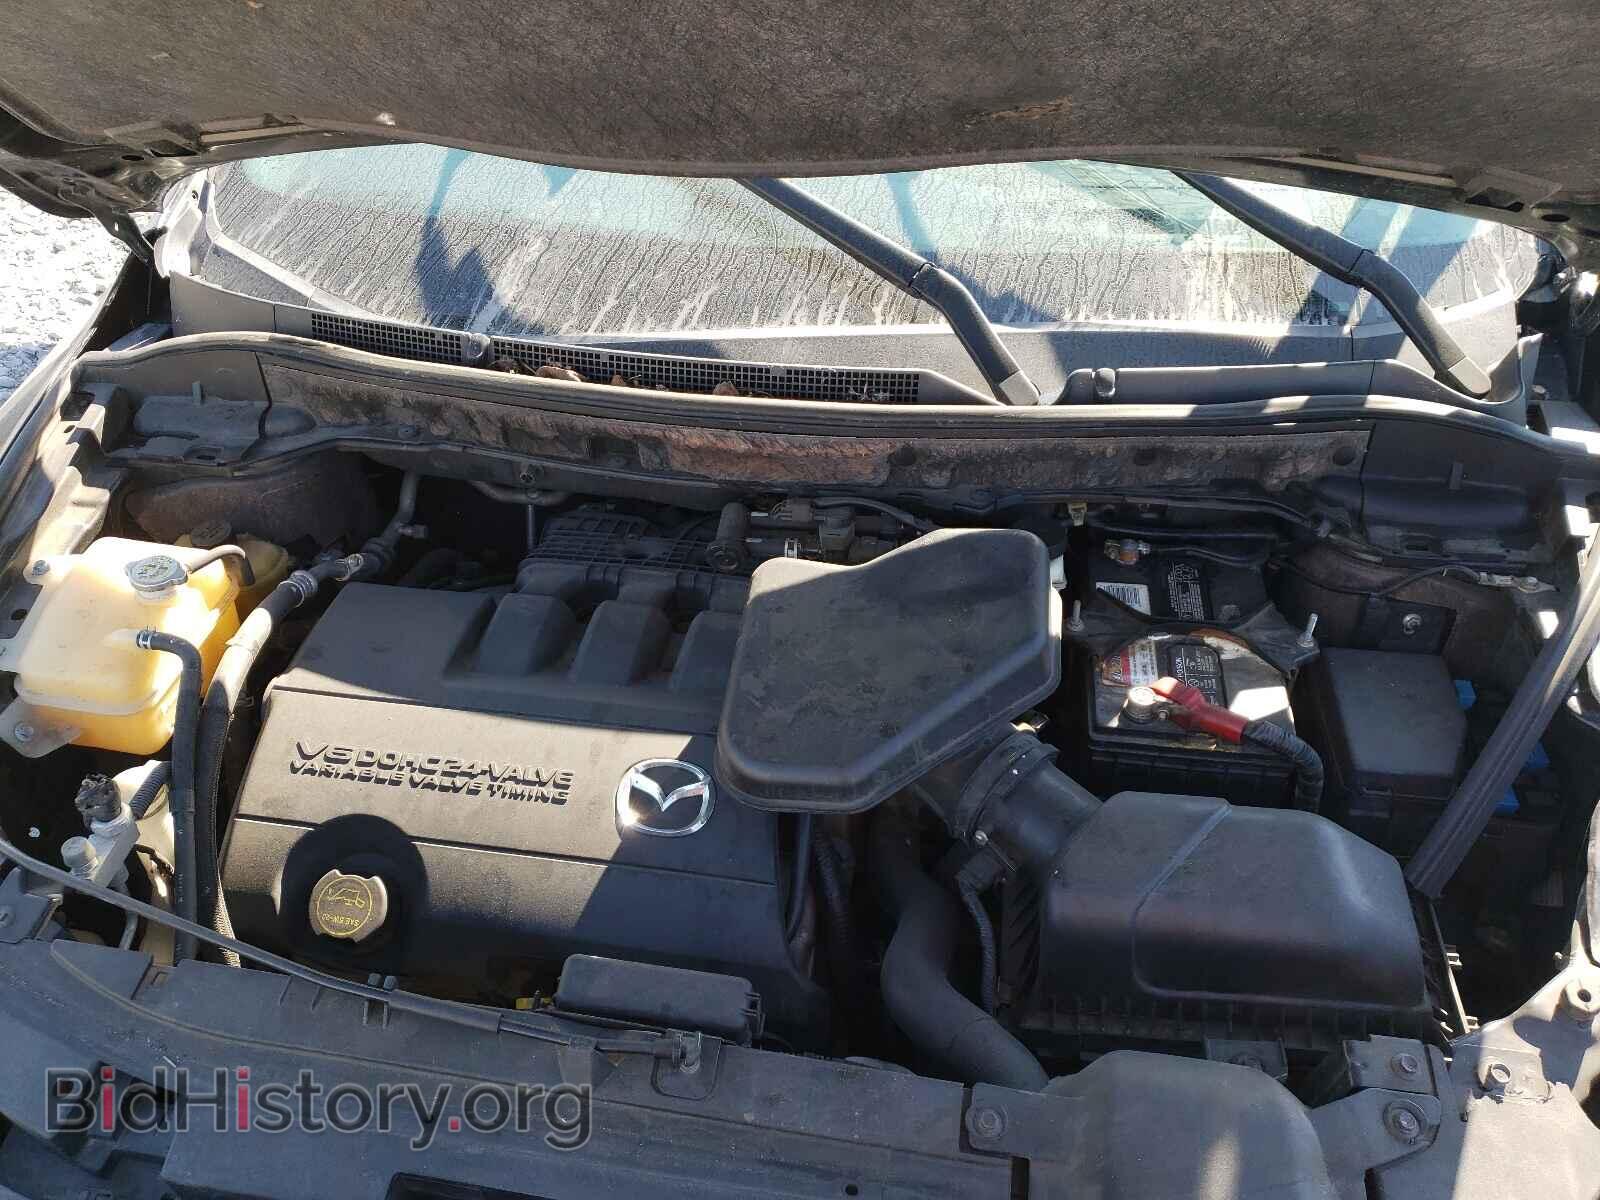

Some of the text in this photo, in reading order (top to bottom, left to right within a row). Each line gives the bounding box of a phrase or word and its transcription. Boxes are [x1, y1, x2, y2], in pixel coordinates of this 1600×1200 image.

[295, 738, 354, 765] V6
[354, 748, 441, 775] DOHC
[289, 760, 570, 806] VARIABLE VALVE TIMING
